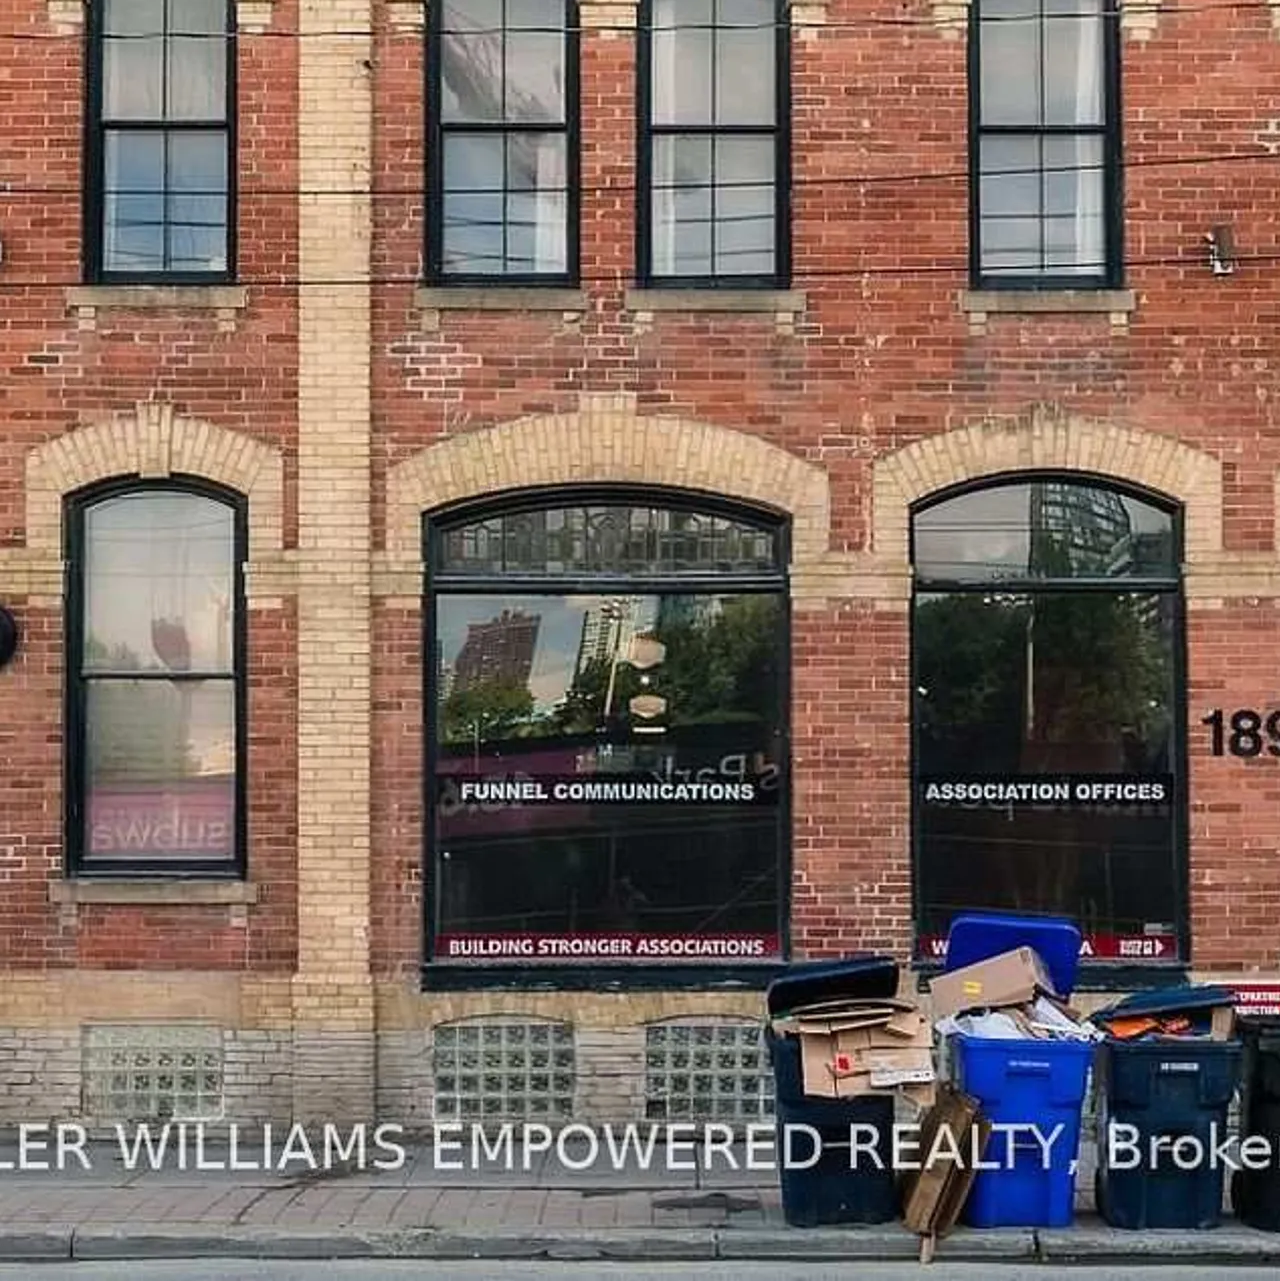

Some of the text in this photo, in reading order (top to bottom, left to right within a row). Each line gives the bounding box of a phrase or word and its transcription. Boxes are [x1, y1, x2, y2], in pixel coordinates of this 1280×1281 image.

[461, 783, 755, 801] FUNNEL COMMUNICATIONS
[925, 783, 1165, 800] ASSOCIATION OFFICES
[449, 939, 765, 955] BUILDING STRONGER ASSOCIATIONS
